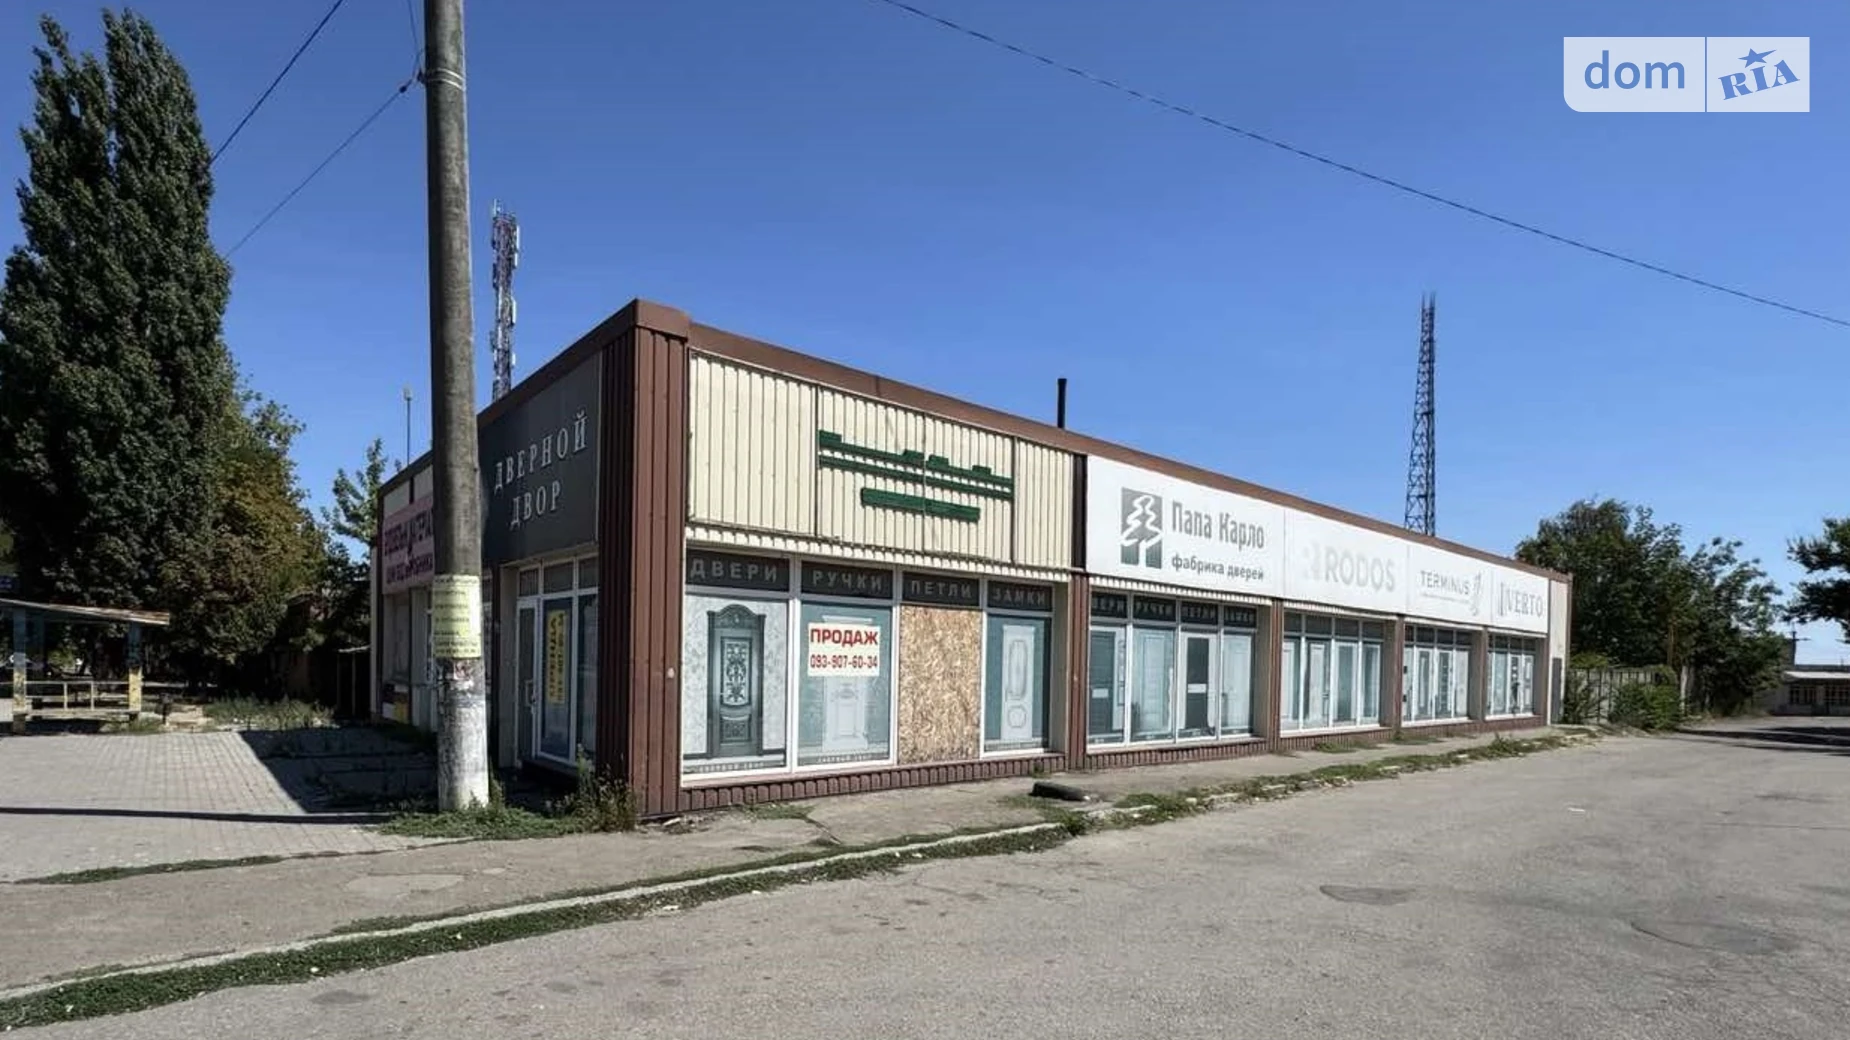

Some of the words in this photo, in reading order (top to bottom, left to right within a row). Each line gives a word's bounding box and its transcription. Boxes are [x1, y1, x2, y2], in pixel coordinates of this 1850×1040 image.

[494, 409, 588, 495] ДВЕРНОЙ
[509, 480, 562, 531] ДВОР
[1172, 500, 1212, 540] Папа
[1219, 512, 1264, 552] Карло
[690, 558, 778, 583] ДВЕРИ
[1172, 553, 1225, 576] фабрика
[1325, 545, 1395, 592] RODOS
[812, 570, 882, 591] РУЧКИ
[911, 580, 972, 599] ПЕТЛИ
[1420, 570, 1470, 595] TERMINUS
[993, 588, 1045, 604] ЗАМКИ
[811, 629, 878, 647] ПРОДАЖ
[810, 654, 878, 669] 093-907-60-34
